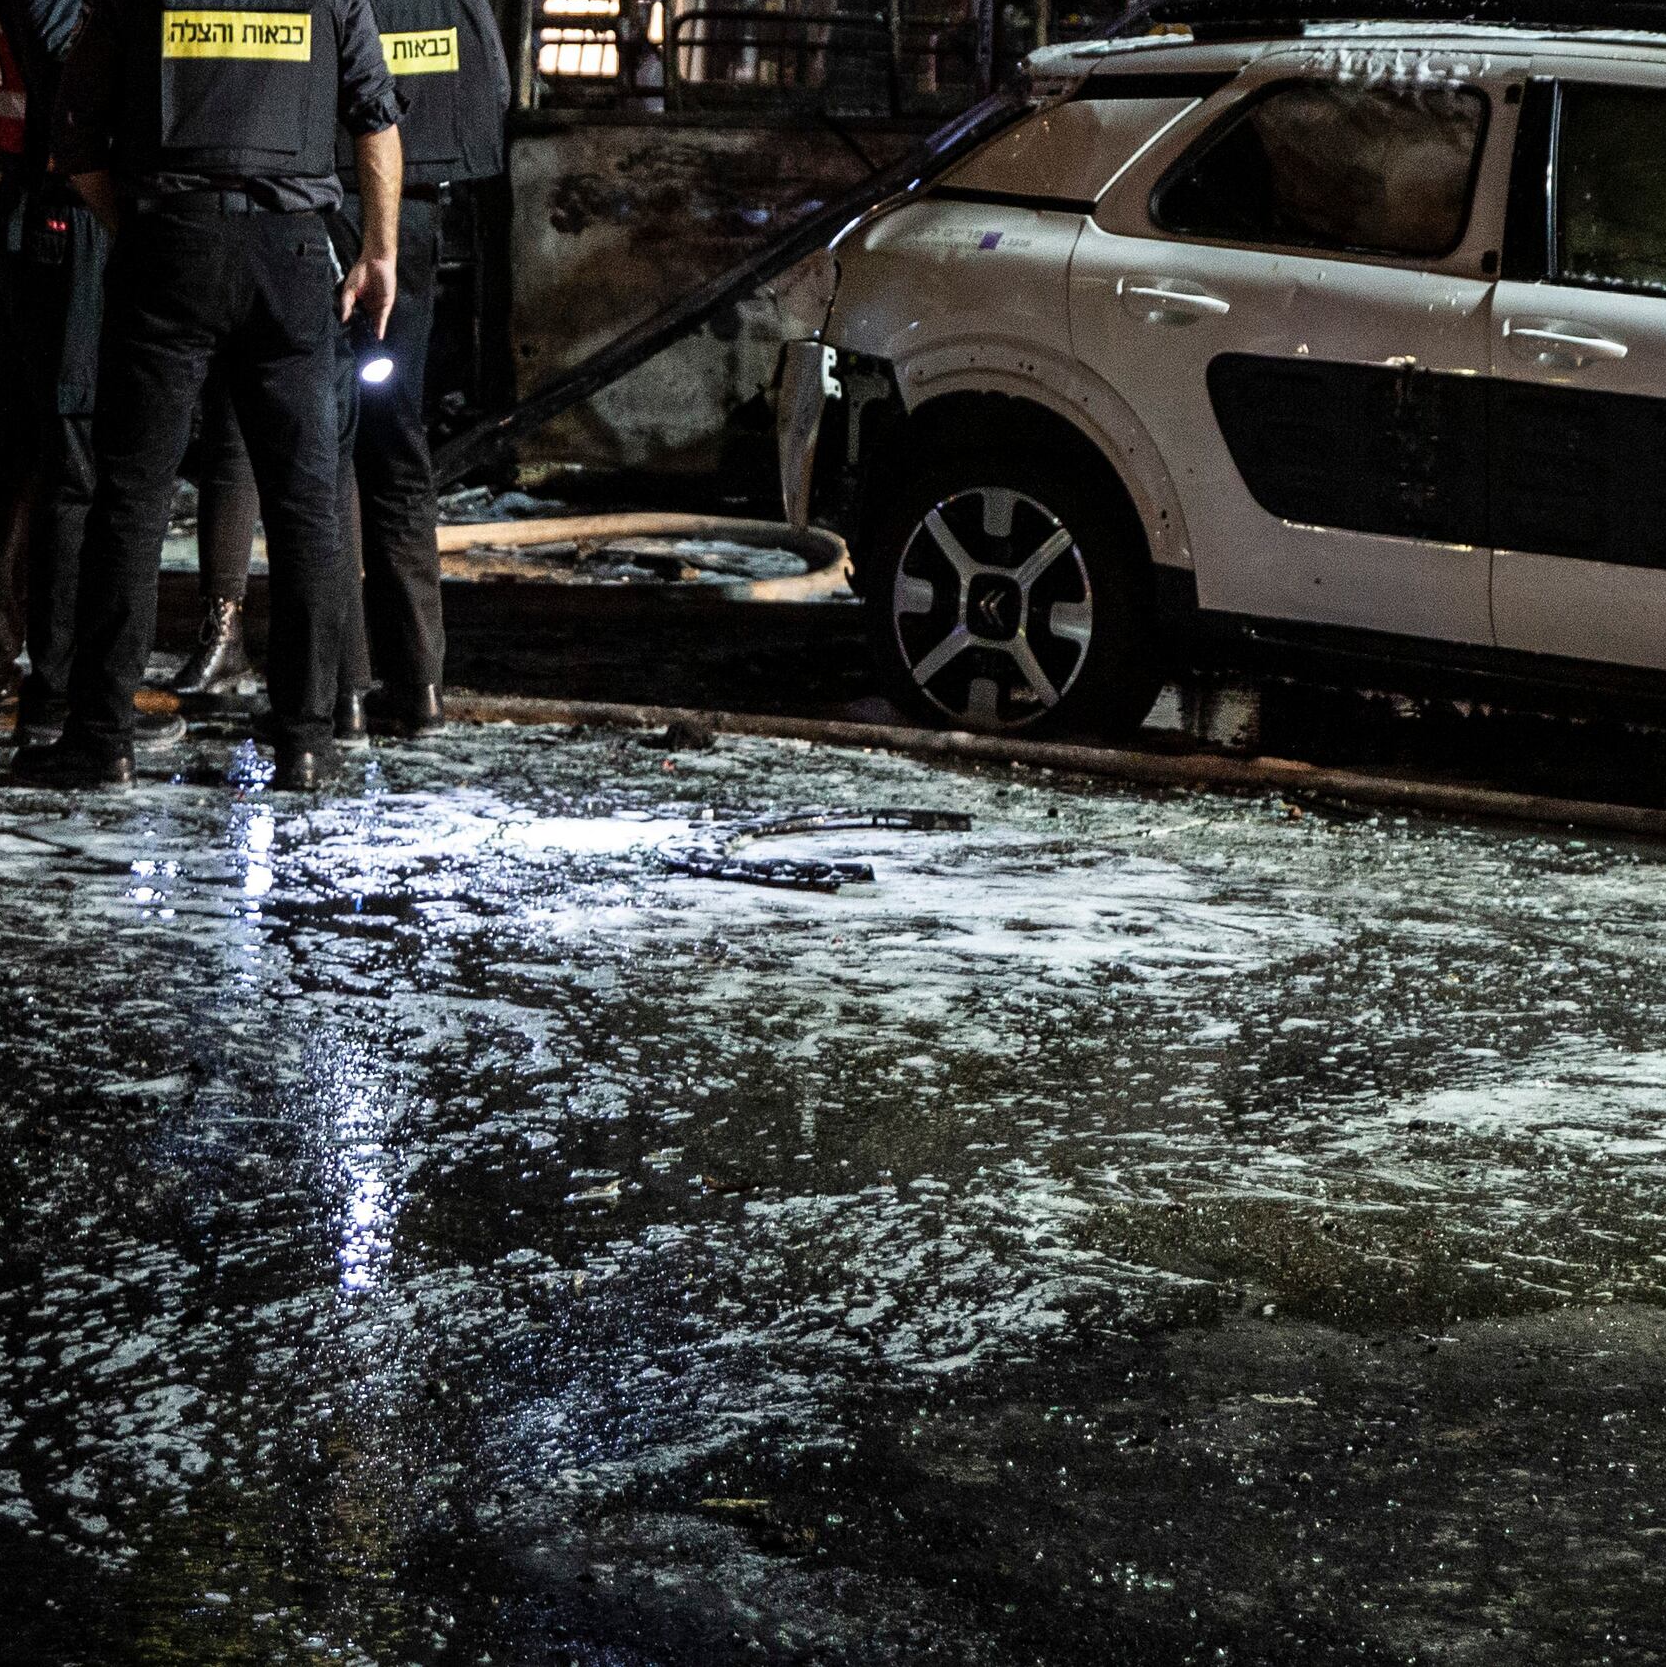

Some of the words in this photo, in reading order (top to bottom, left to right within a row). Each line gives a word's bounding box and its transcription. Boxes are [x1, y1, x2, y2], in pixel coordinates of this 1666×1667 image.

[169, 18, 233, 43] והצלה
[241, 24, 304, 45] כבאות
[393, 37, 450, 59] כבאות
